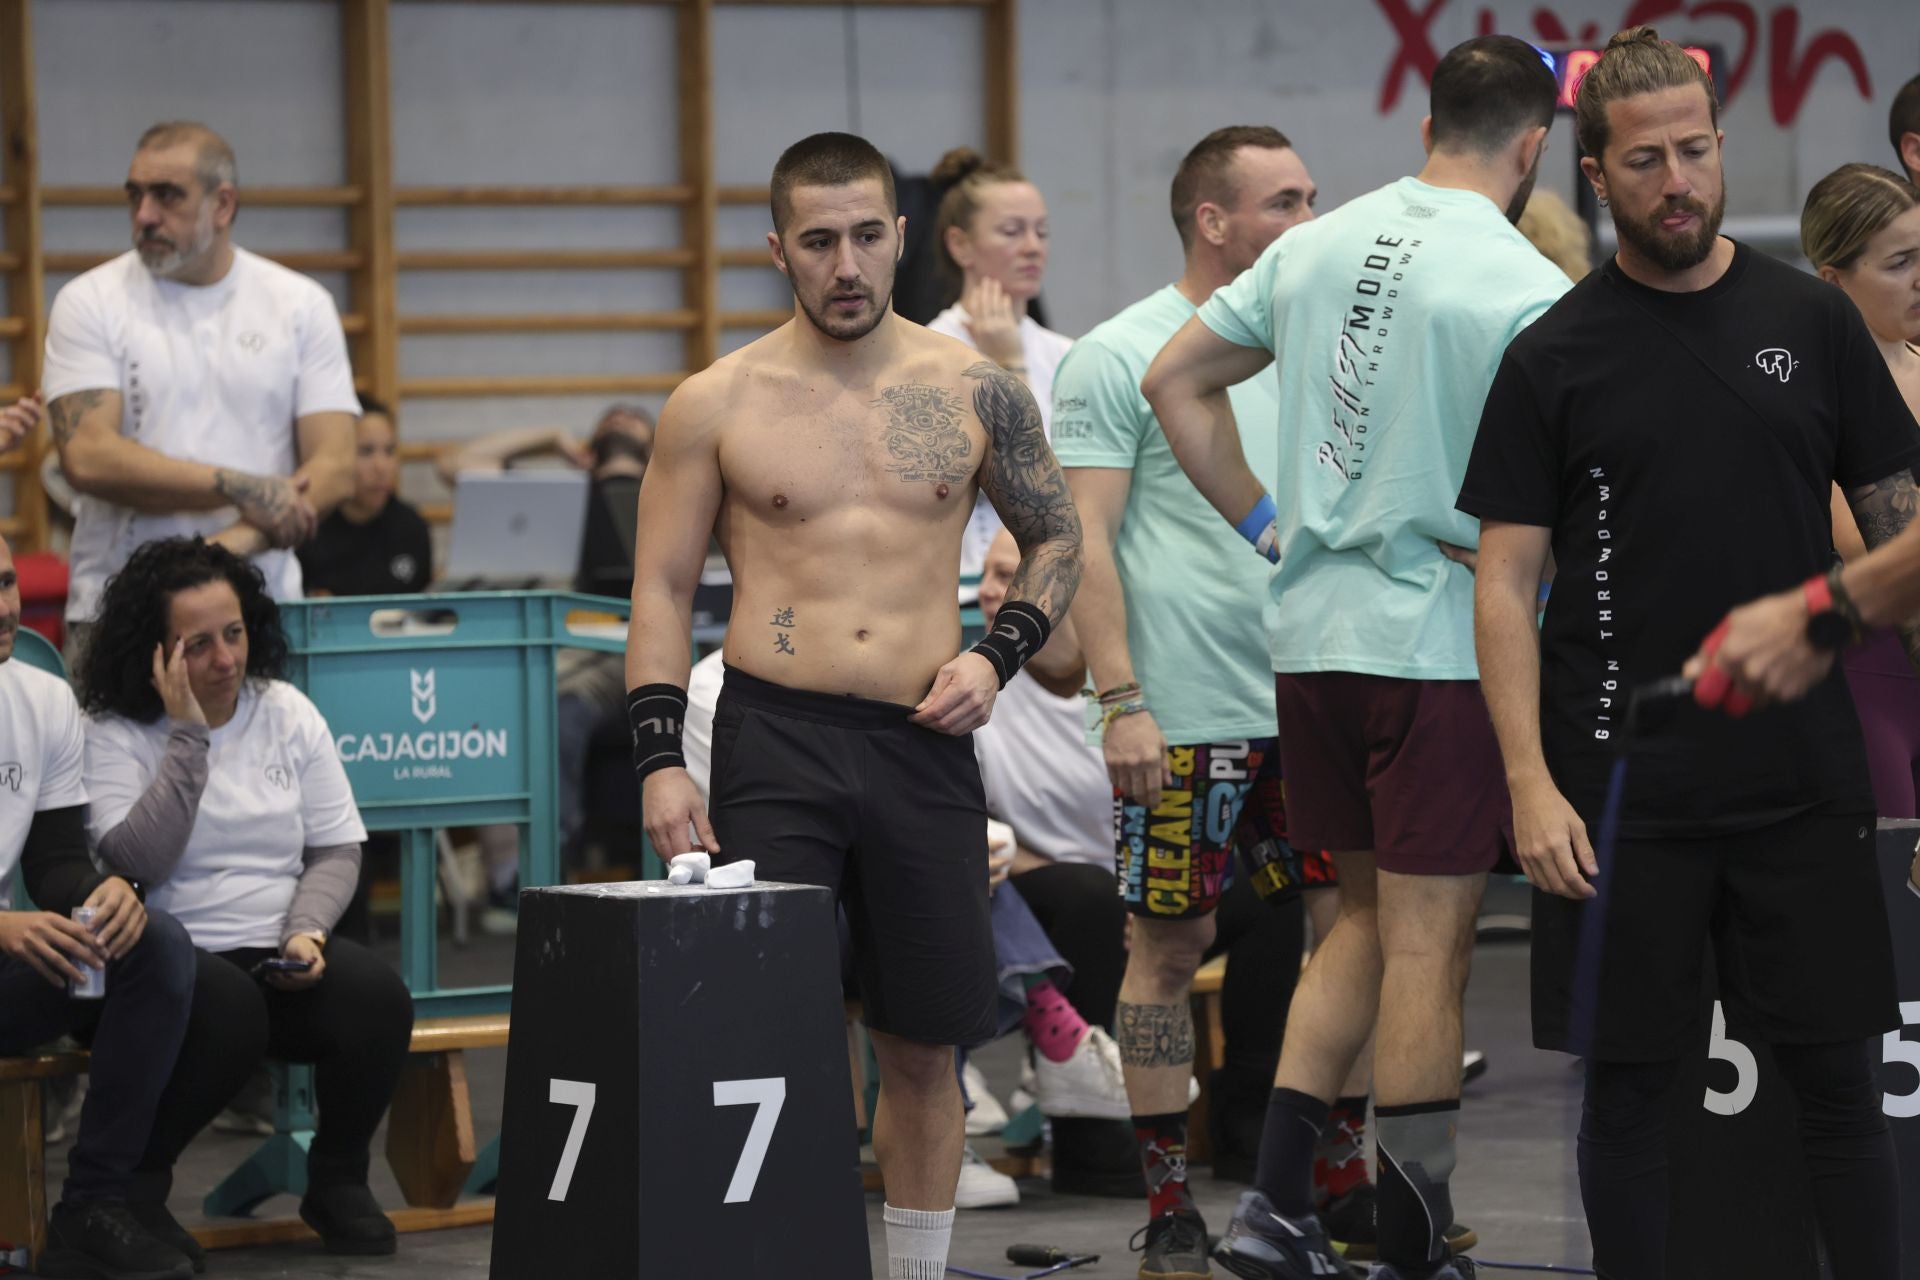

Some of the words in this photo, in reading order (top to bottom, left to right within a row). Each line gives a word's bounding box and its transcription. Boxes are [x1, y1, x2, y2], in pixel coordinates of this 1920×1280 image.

[1349, 234, 1404, 330] MODE
[1364, 239, 1423, 387] THROWDOWN
[1589, 466, 1613, 640] THROWDOWN
[1595, 660, 1620, 740] GIJÓN
[393, 766, 410, 780] LA
[412, 765, 453, 779] RURAL
[1115, 850, 1128, 897] WALL
[1147, 789, 1193, 915] CLEAN
[1703, 1000, 1759, 1116] 5
[1882, 1001, 1920, 1118] 5
[547, 1078, 597, 1202] 7
[712, 1076, 786, 1204] 7
